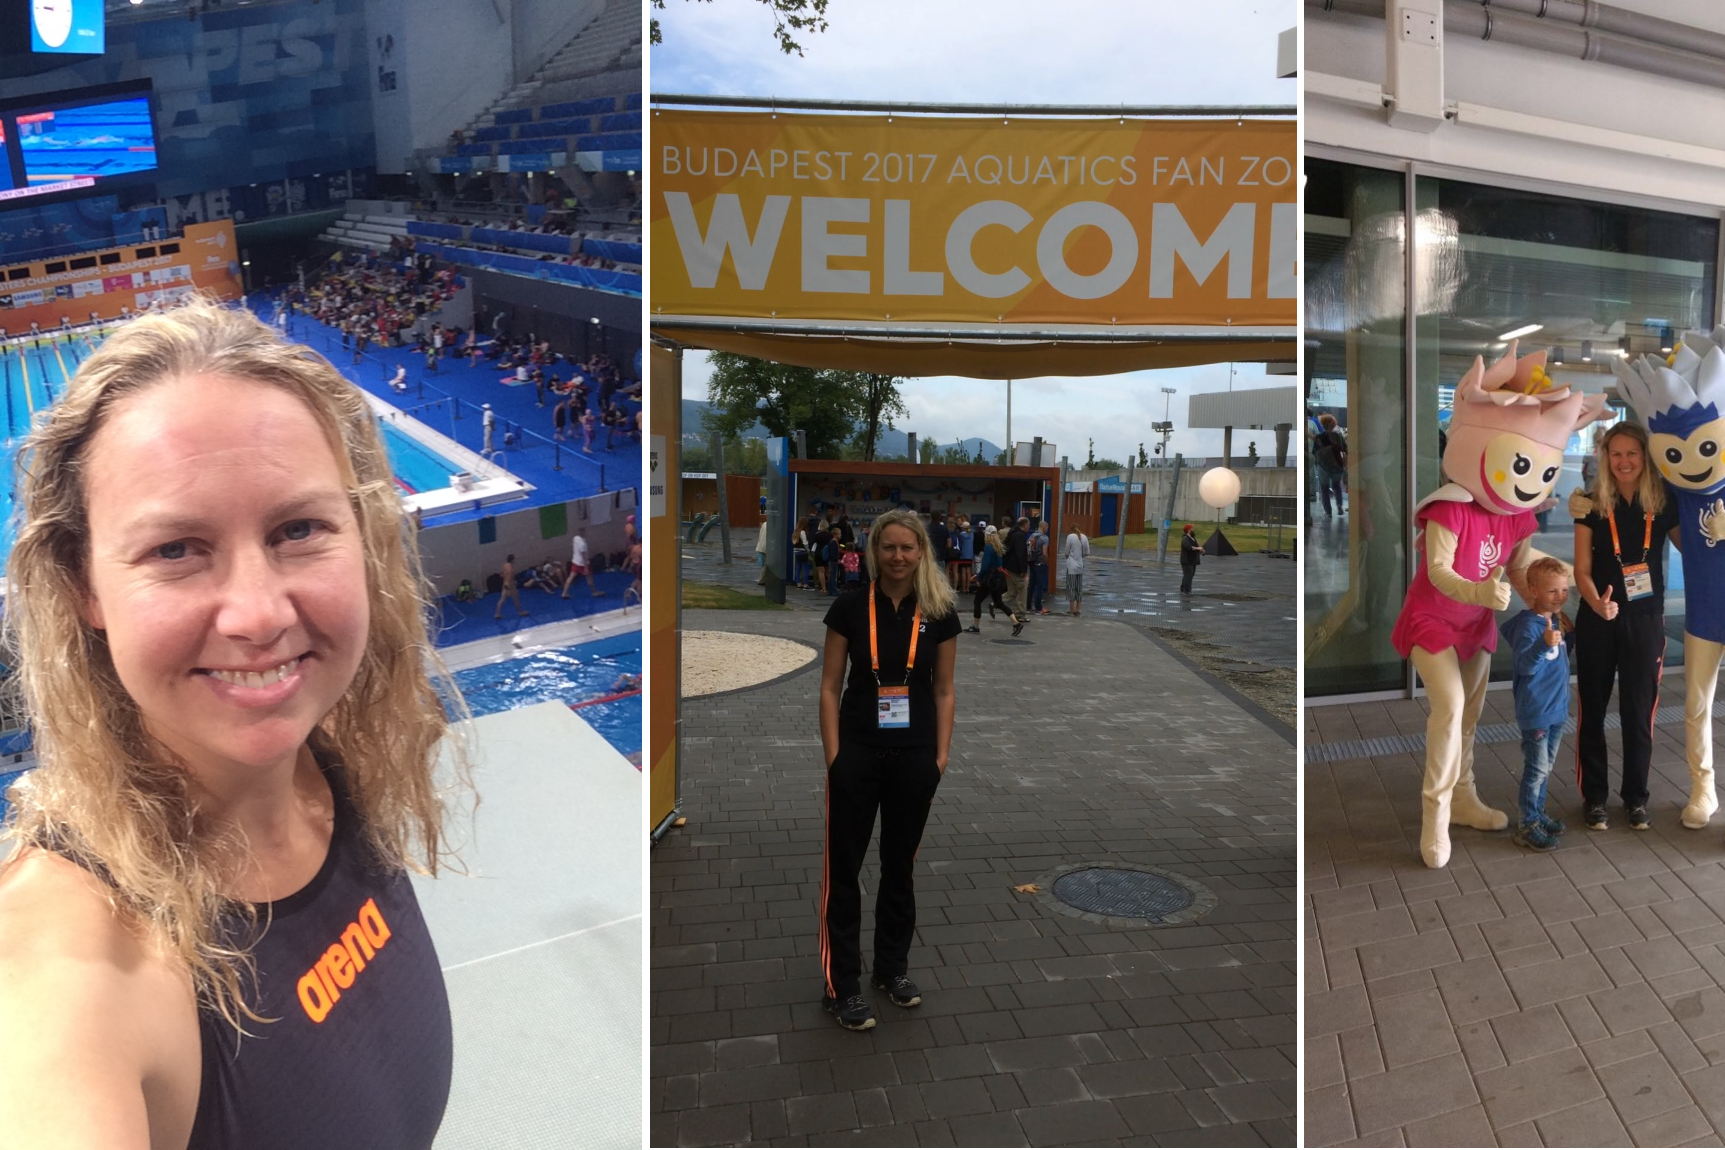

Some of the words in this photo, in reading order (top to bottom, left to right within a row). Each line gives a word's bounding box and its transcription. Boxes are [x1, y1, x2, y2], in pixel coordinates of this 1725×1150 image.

[663, 145, 853, 182] BUDAPEST
[862, 152, 938, 183] 2017
[947, 154, 1137, 186] AQUATICS
[1153, 156, 1224, 186] FAN
[1238, 156, 1292, 186] ZO
[27, 267, 101, 285] CHAMPIONSHIPS
[296, 898, 392, 1023] arena
